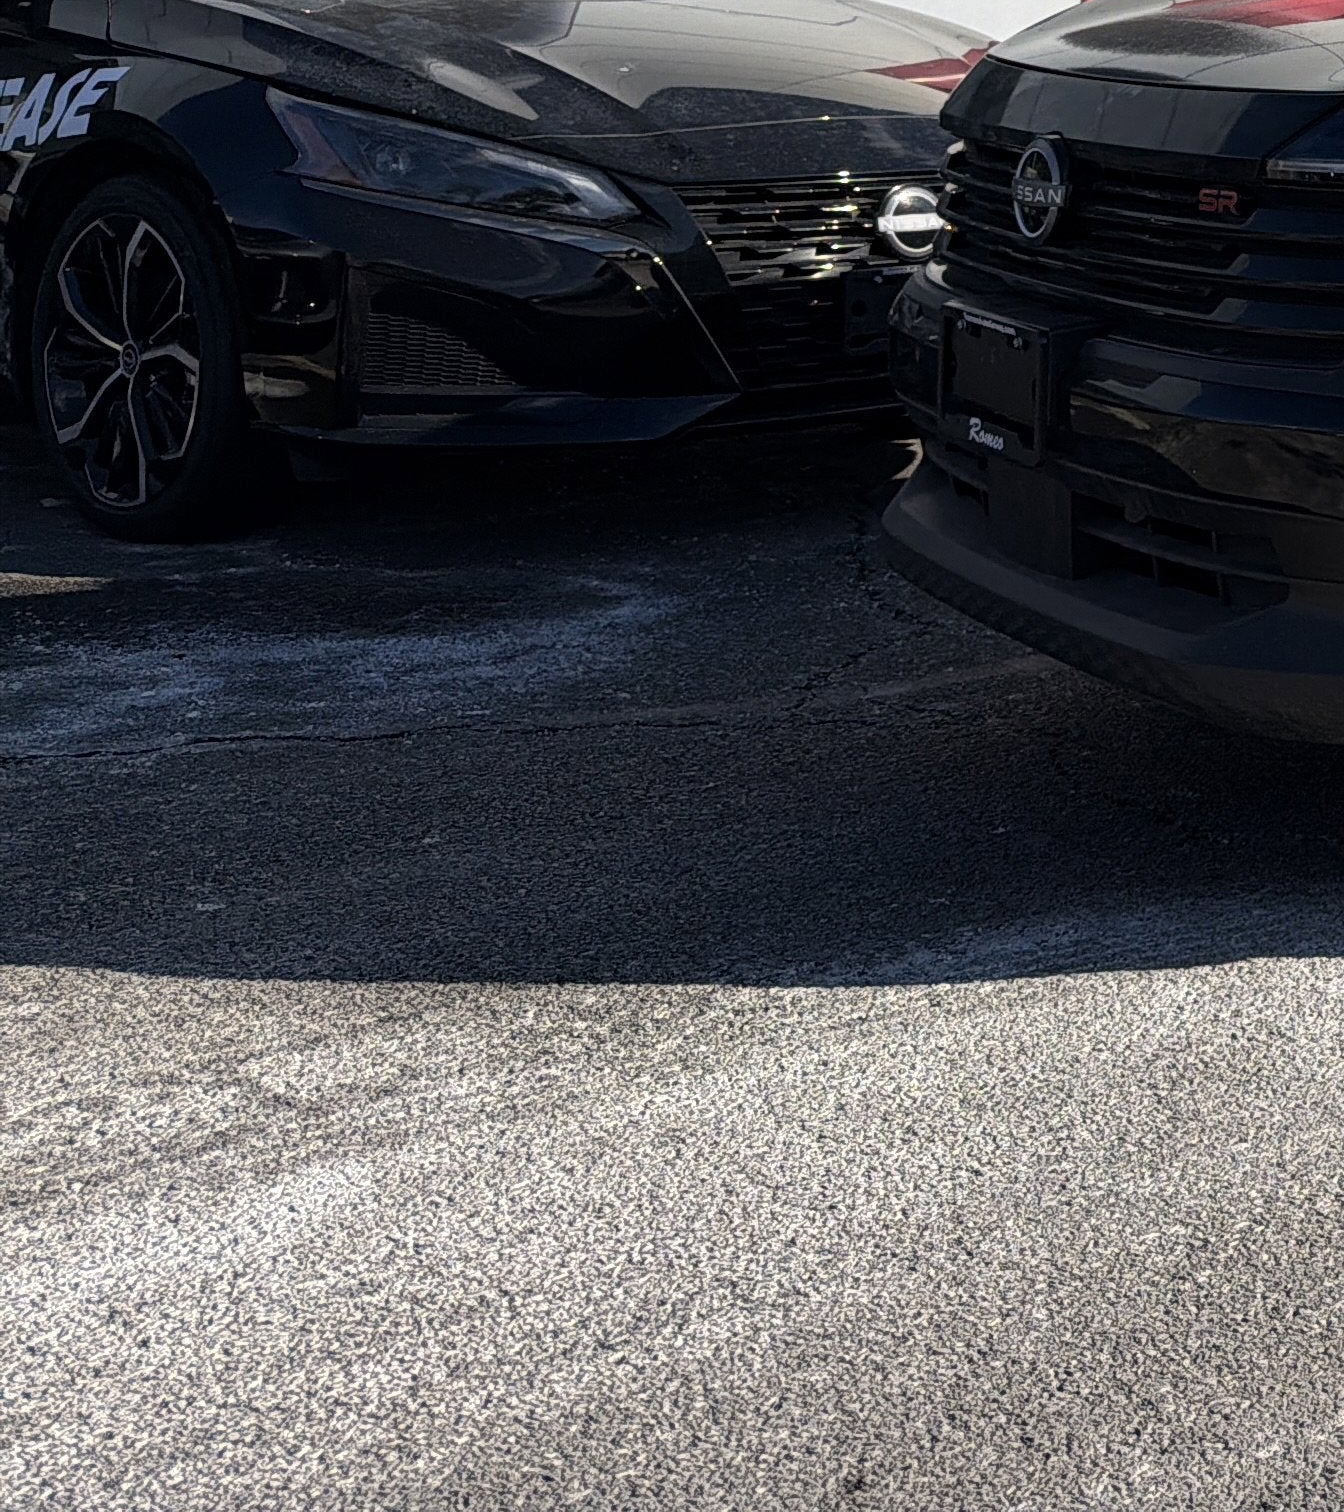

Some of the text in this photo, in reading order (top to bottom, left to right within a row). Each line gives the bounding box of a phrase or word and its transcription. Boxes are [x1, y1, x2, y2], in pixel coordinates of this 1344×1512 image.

[1015, 184, 1063, 204] SSAN
[1198, 188, 1240, 216] SR
[879, 215, 946, 233] NISSA
[968, 416, 1005, 451] Romeo
